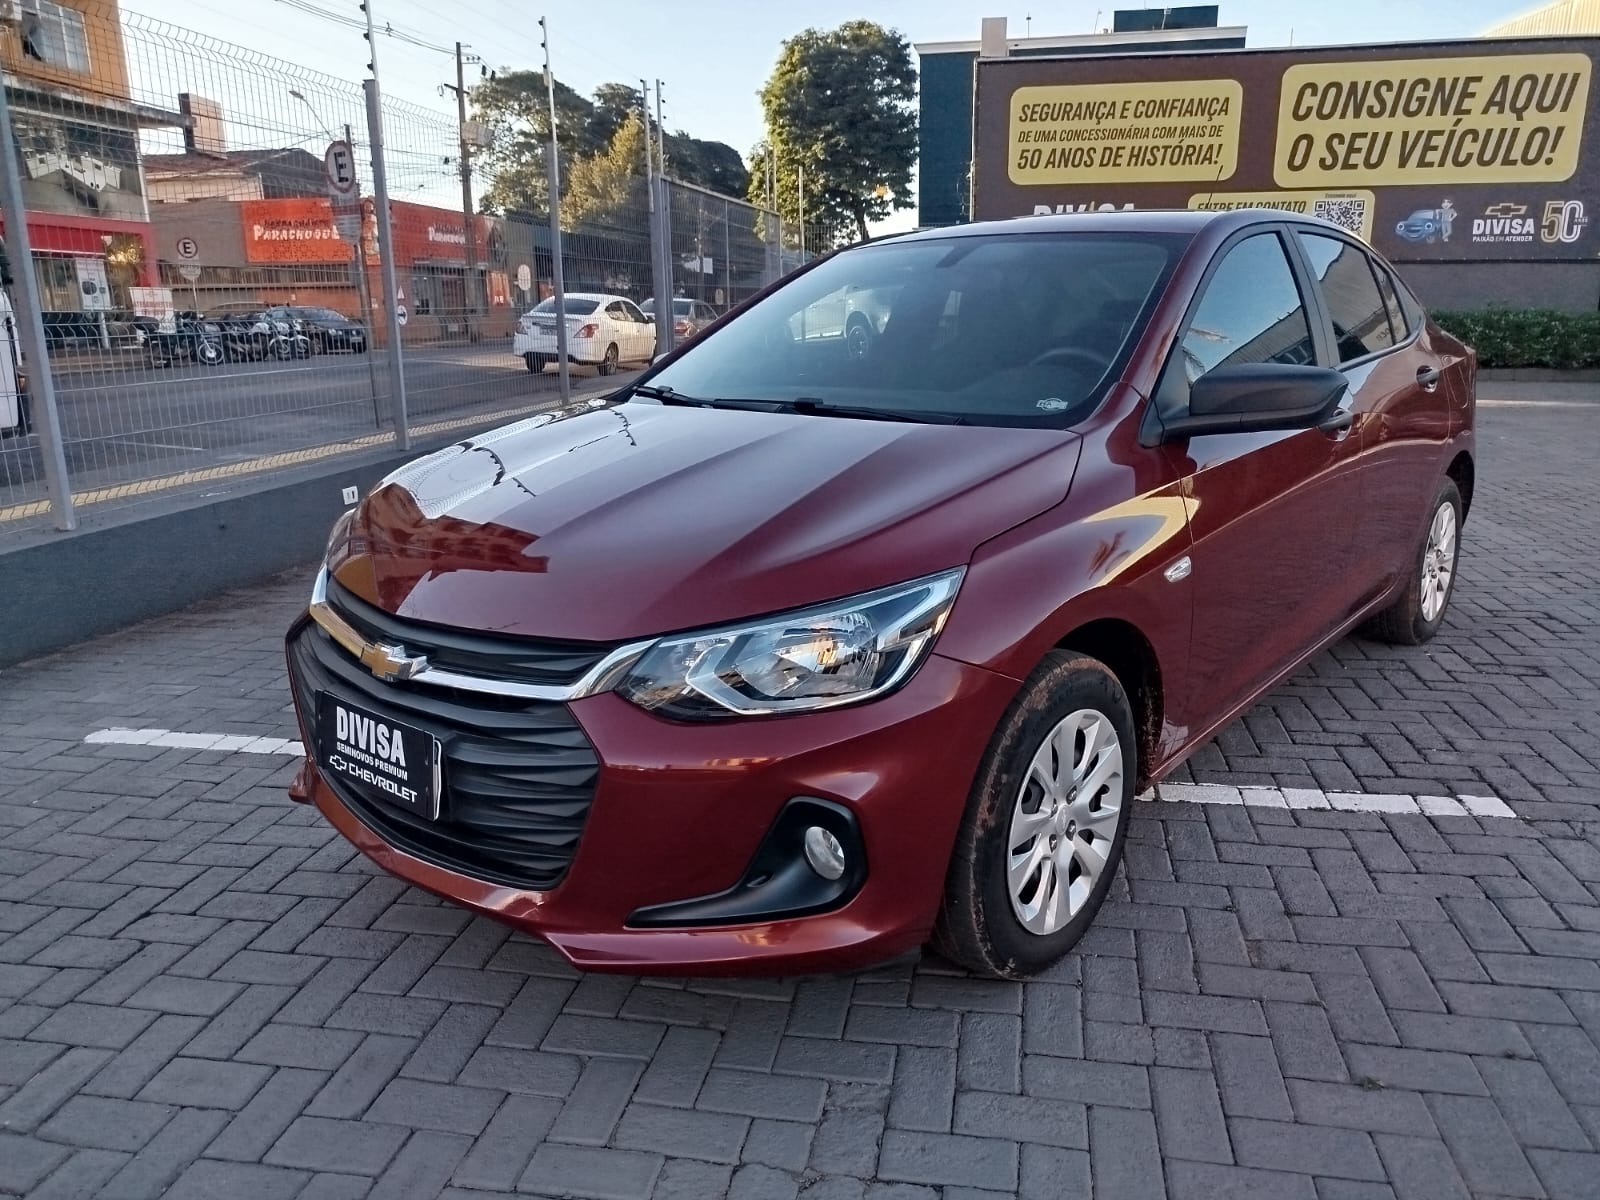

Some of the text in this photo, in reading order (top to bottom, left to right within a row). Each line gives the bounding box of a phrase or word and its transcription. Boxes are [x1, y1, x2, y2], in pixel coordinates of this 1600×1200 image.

[1019, 97, 1230, 125] SEGURANÇA E CONFIANÇA
[1291, 72, 1581, 122] CONSIGNE AQUI
[1018, 124, 1225, 143] DE UMA CONCESSIONÁRIA COM MAIS DE
[1287, 118, 1565, 172] O SEU VEÍCULO!
[333, 151, 350, 183] E
[1017, 138, 1223, 169] 50 ANOS DE HISTÓRIA!
[1472, 218, 1535, 235] DIVISA
[183, 241, 192, 254] E
[336, 705, 406, 768] DIVISA
[336, 741, 408, 781] SEMINOVOS PREMIUM
[348, 762, 418, 803] CHEVROLET
